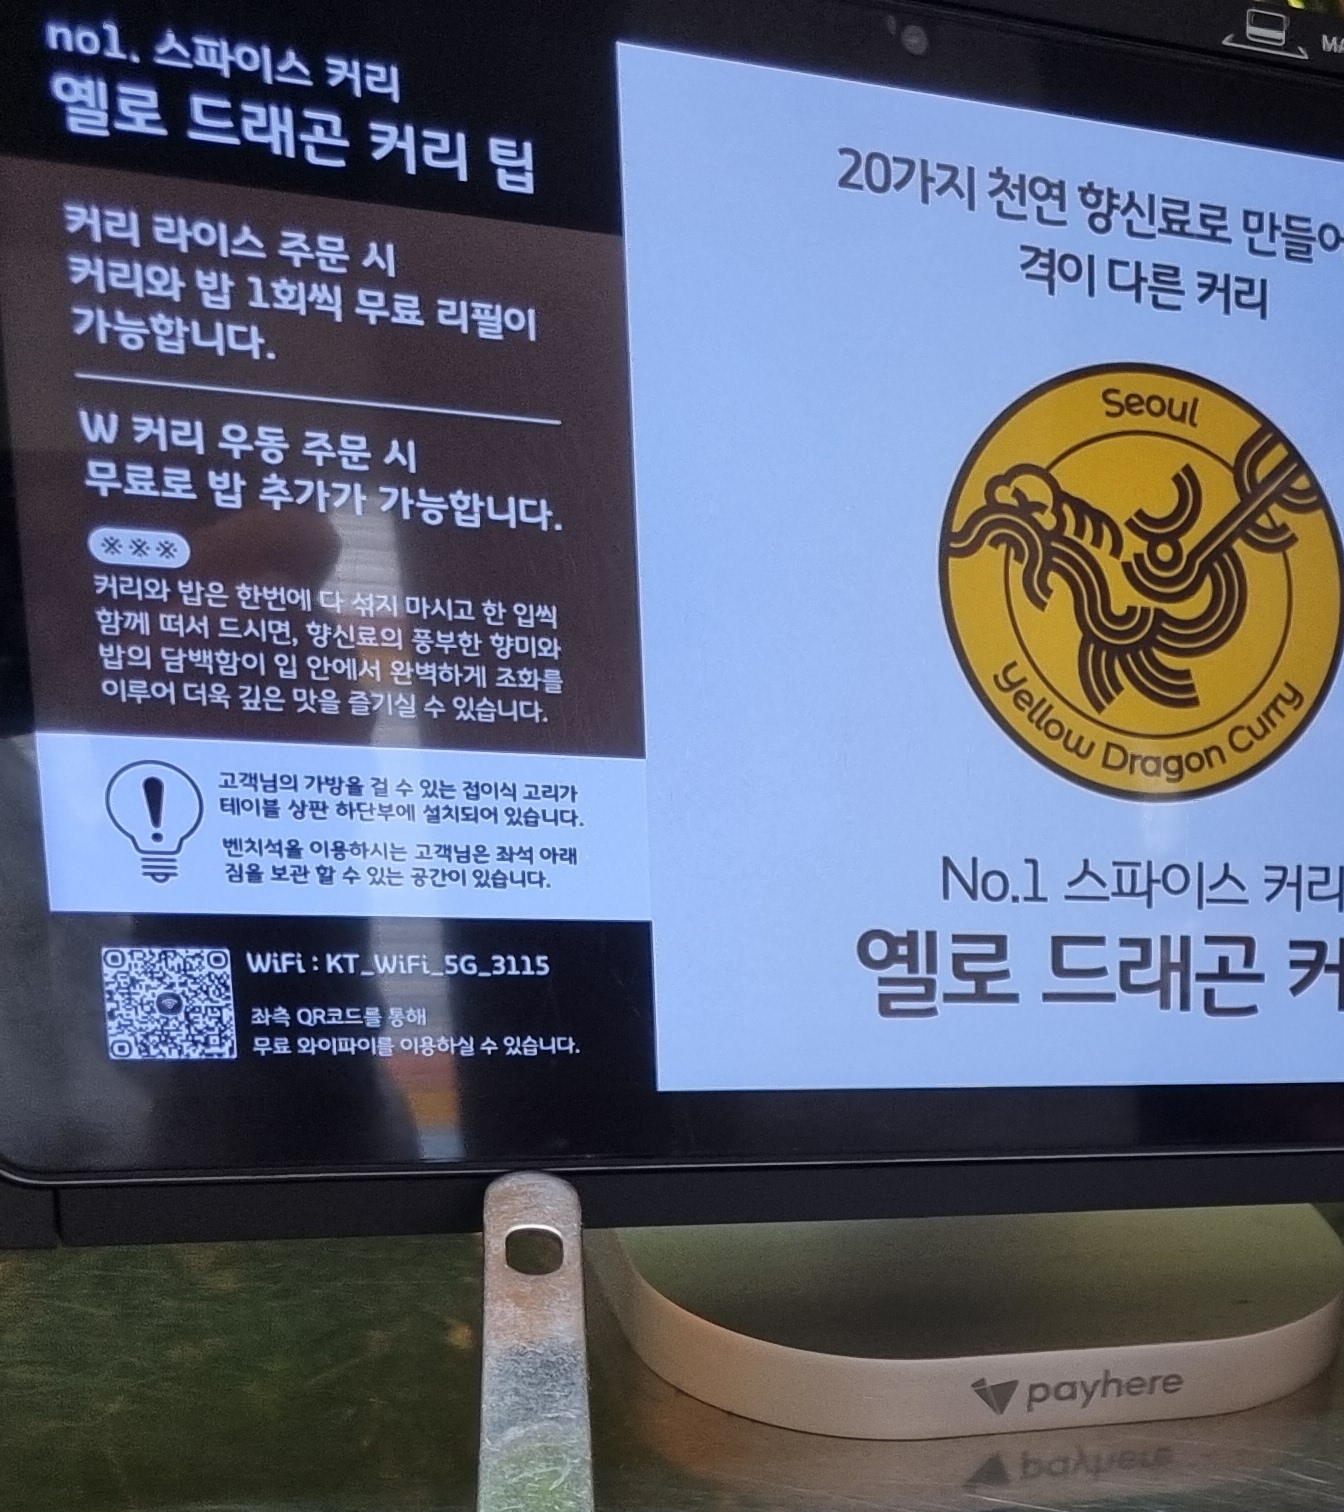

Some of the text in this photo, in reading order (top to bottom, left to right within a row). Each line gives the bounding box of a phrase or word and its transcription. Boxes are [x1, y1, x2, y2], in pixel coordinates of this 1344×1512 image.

[46, 21, 400, 104] no1. 스파이스 커리
[52, 73, 534, 194] 옐로 드래곤 커리 팁
[837, 147, 976, 211] 20가지
[987, 166, 1068, 227] 천연
[1077, 181, 1232, 245] 향신료로
[64, 203, 395, 277] 커리 라이스 주문 시
[67, 255, 536, 341] 커리와 밥 1회씩 무료 리필이
[1019, 244, 1268, 321] 격이 다른 커리
[71, 305, 276, 360] 가능합니다.
[1100, 387, 1200, 428] Seoul
[79, 409, 416, 474] W 커리 우동 주문 시
[85, 459, 563, 531] 무료로 밥 추가가 가능합니다.
[93, 574, 170, 602] 커리와
[178, 579, 229, 608] 밥은
[235, 582, 312, 612] 한번에
[319, 590, 343, 614] 다
[405, 596, 476, 621] 마시고
[481, 599, 506, 626] 한
[513, 603, 558, 629] 입씩
[96, 607, 562, 660] 함께 떠서 드시면, 향신료의 풍부한 향미와
[99, 643, 563, 694] 밥의 담백함이 입 안에서 완벽하게 조화를
[101, 679, 548, 723] 이루어 더욱 깊은 맛을 즐기실 수 있습니다.
[993, 659, 1305, 783] Yellow Dragon Curry
[218, 771, 578, 803] 고객님의 가방을 걸 수 있는 접이식 고리가
[219, 797, 585, 827] 테이블 상판 하단부에 설치되어 있습니다.
[222, 837, 577, 866] 벤치석을 이용하시는 고객님은 좌석 아래
[225, 862, 552, 890] 짐을 보관 할 수 있는 공간이 있습니다.
[942, 855, 1344, 912] No.1 스파이스 커리
[246, 951, 306, 975] WiFi
[325, 953, 550, 977] KT_WiFi_5G_3115
[856, 929, 1020, 1019] 옐로
[1041, 934, 1265, 1018] 드래곤
[251, 1007, 427, 1028] 좌측 QR코드를 통해
[253, 1036, 581, 1057] 무료 와이파이를 이용하실 수 있습니다.
[1027, 1369, 1184, 1413] payhere
